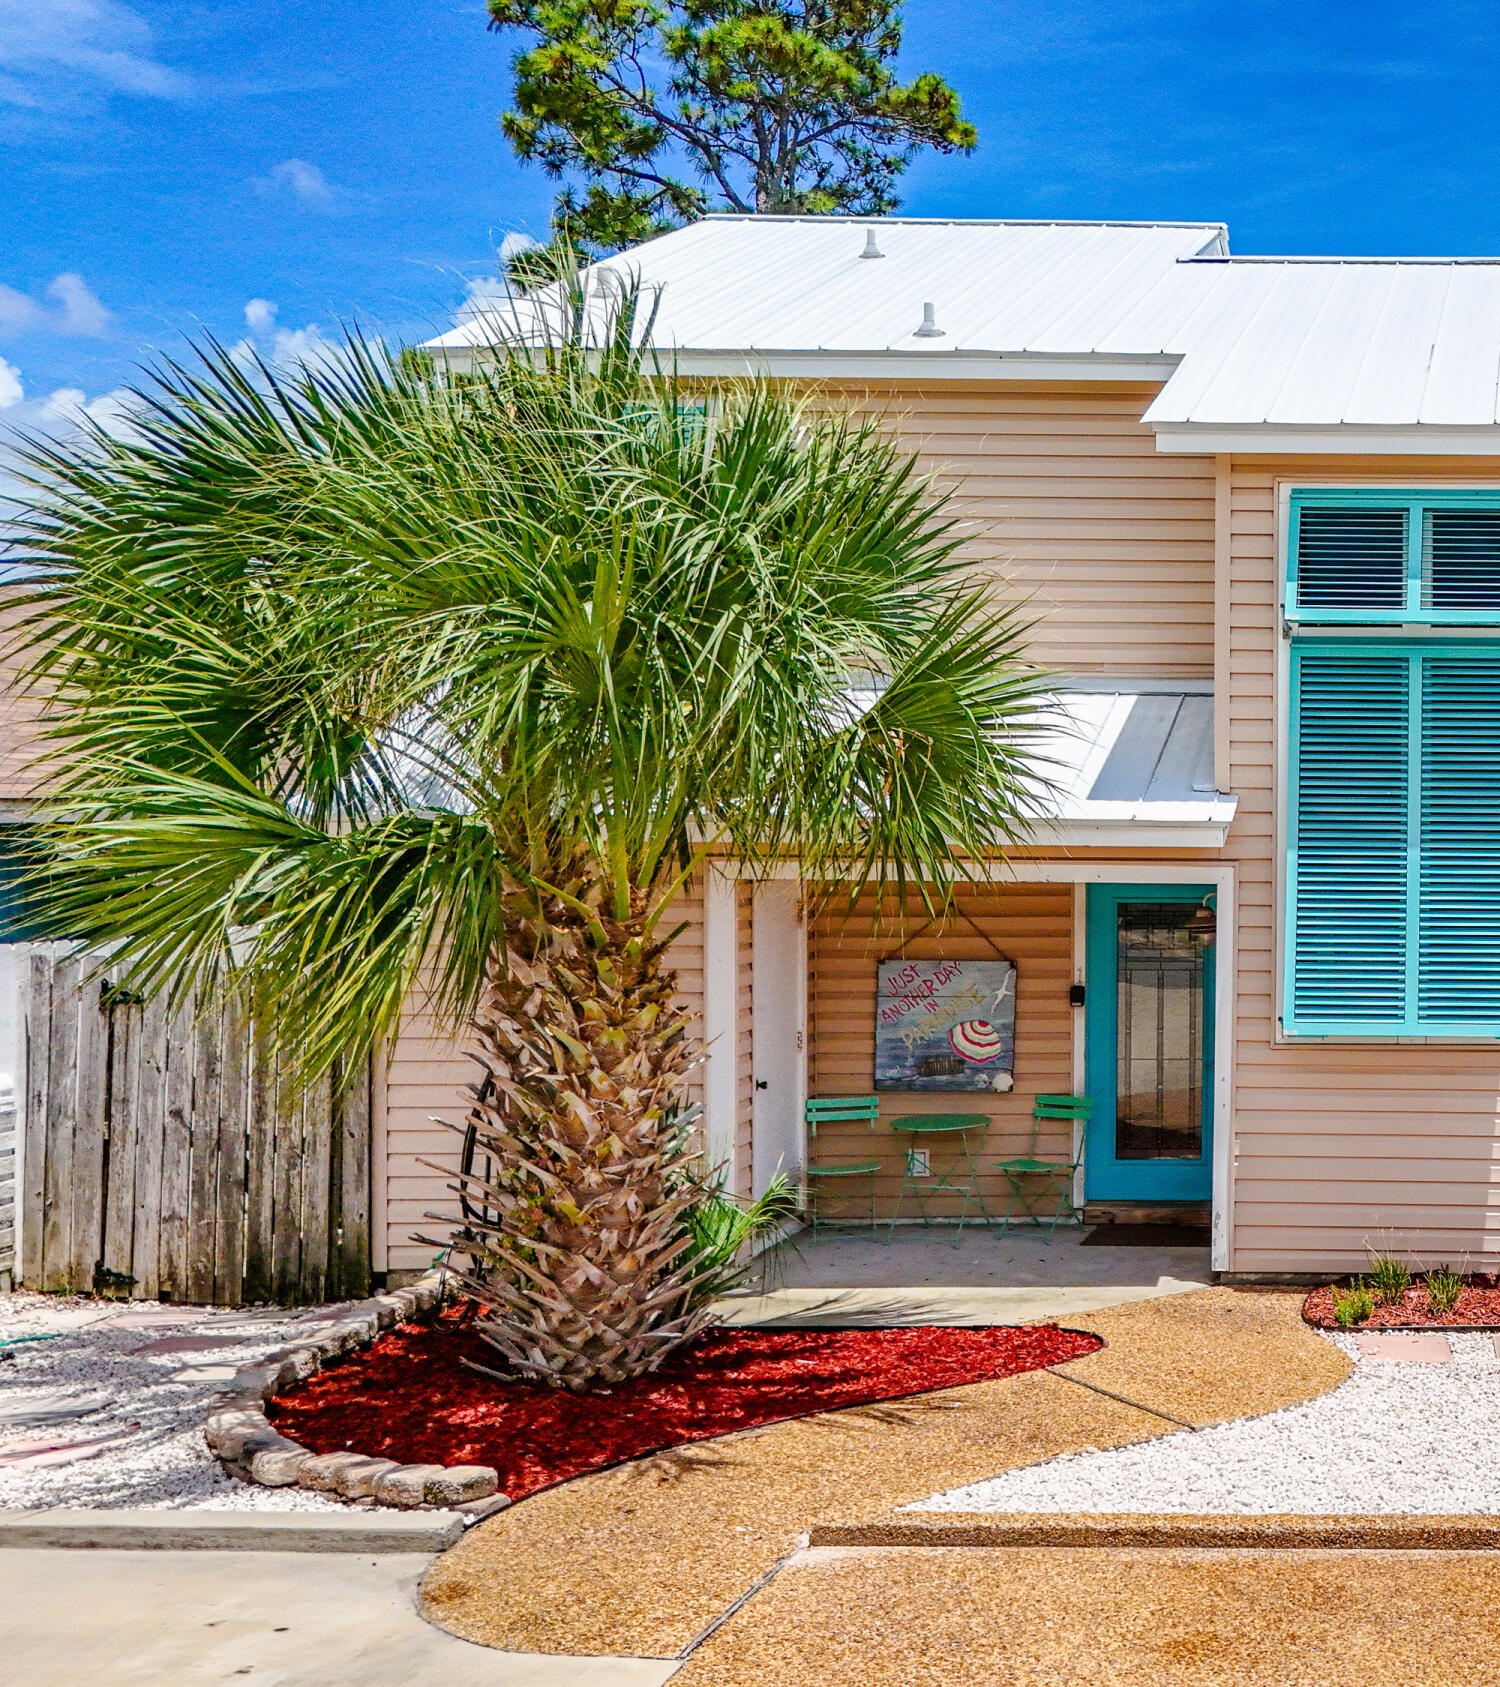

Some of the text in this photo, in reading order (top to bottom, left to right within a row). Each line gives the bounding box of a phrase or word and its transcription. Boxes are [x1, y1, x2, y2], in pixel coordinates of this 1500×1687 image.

[881, 961, 962, 1025] ANOTHER DAY
[923, 999, 939, 1014] IN
